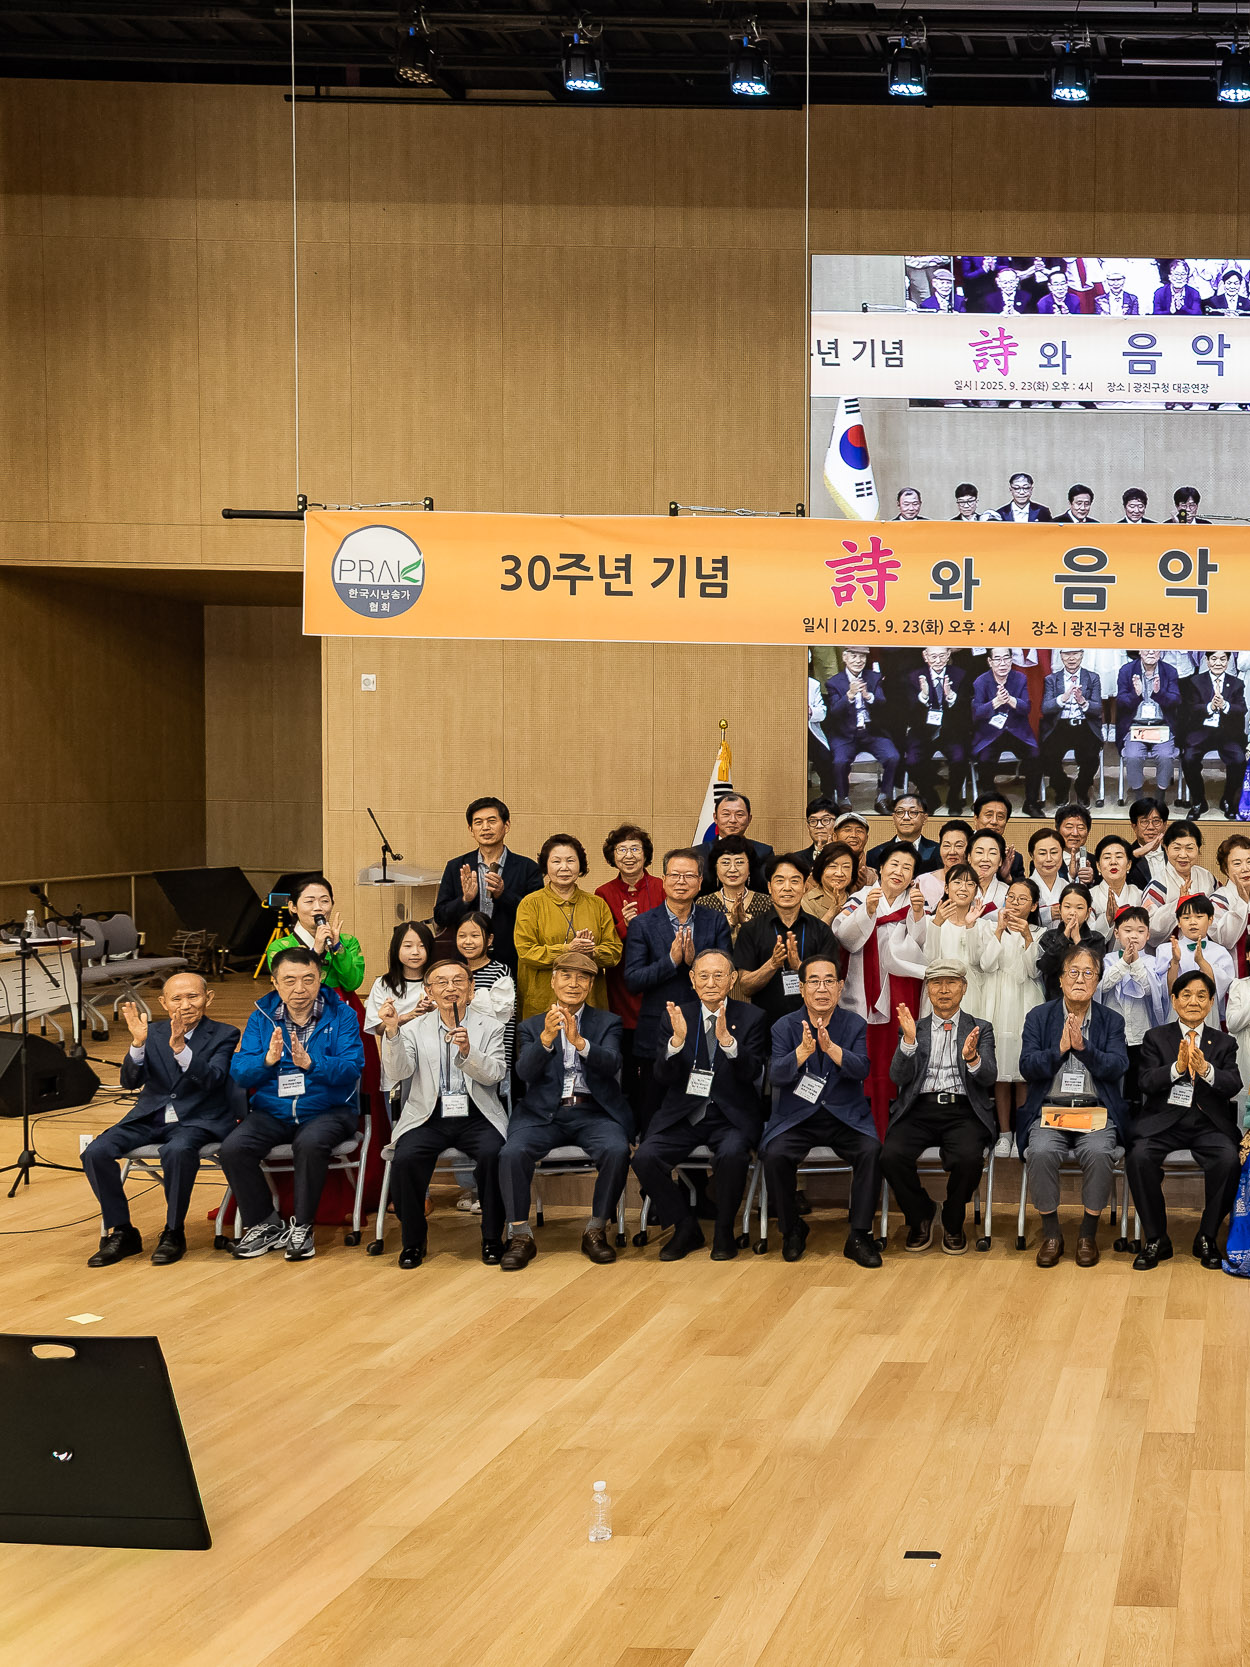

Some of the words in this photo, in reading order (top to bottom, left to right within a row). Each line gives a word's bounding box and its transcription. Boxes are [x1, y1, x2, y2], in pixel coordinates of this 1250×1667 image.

[810, 338, 840, 367] 년
[852, 338, 904, 368] 기념
[1051, 380, 1070, 392] 오후
[1106, 381, 1126, 393] 장소
[1132, 382, 1170, 394] 광진구청
[1172, 383, 1210, 395] 대공연장
[338, 558, 422, 584] PRAK
[500, 553, 635, 598] 30주년
[650, 555, 730, 599] 기념
[348, 588, 411, 600] 한국시낭송가
[802, 617, 829, 634] 일시
[841, 618, 881, 634] 2025.
[885, 619, 898, 635] 9.
[902, 619, 944, 636] 23(화)
[948, 619, 976, 636] 오후
[988, 620, 1010, 636] 4시
[1031, 620, 1059, 637] 장소
[1070, 621, 1125, 638] 광진구청
[1129, 621, 1186, 639] 대공연장
